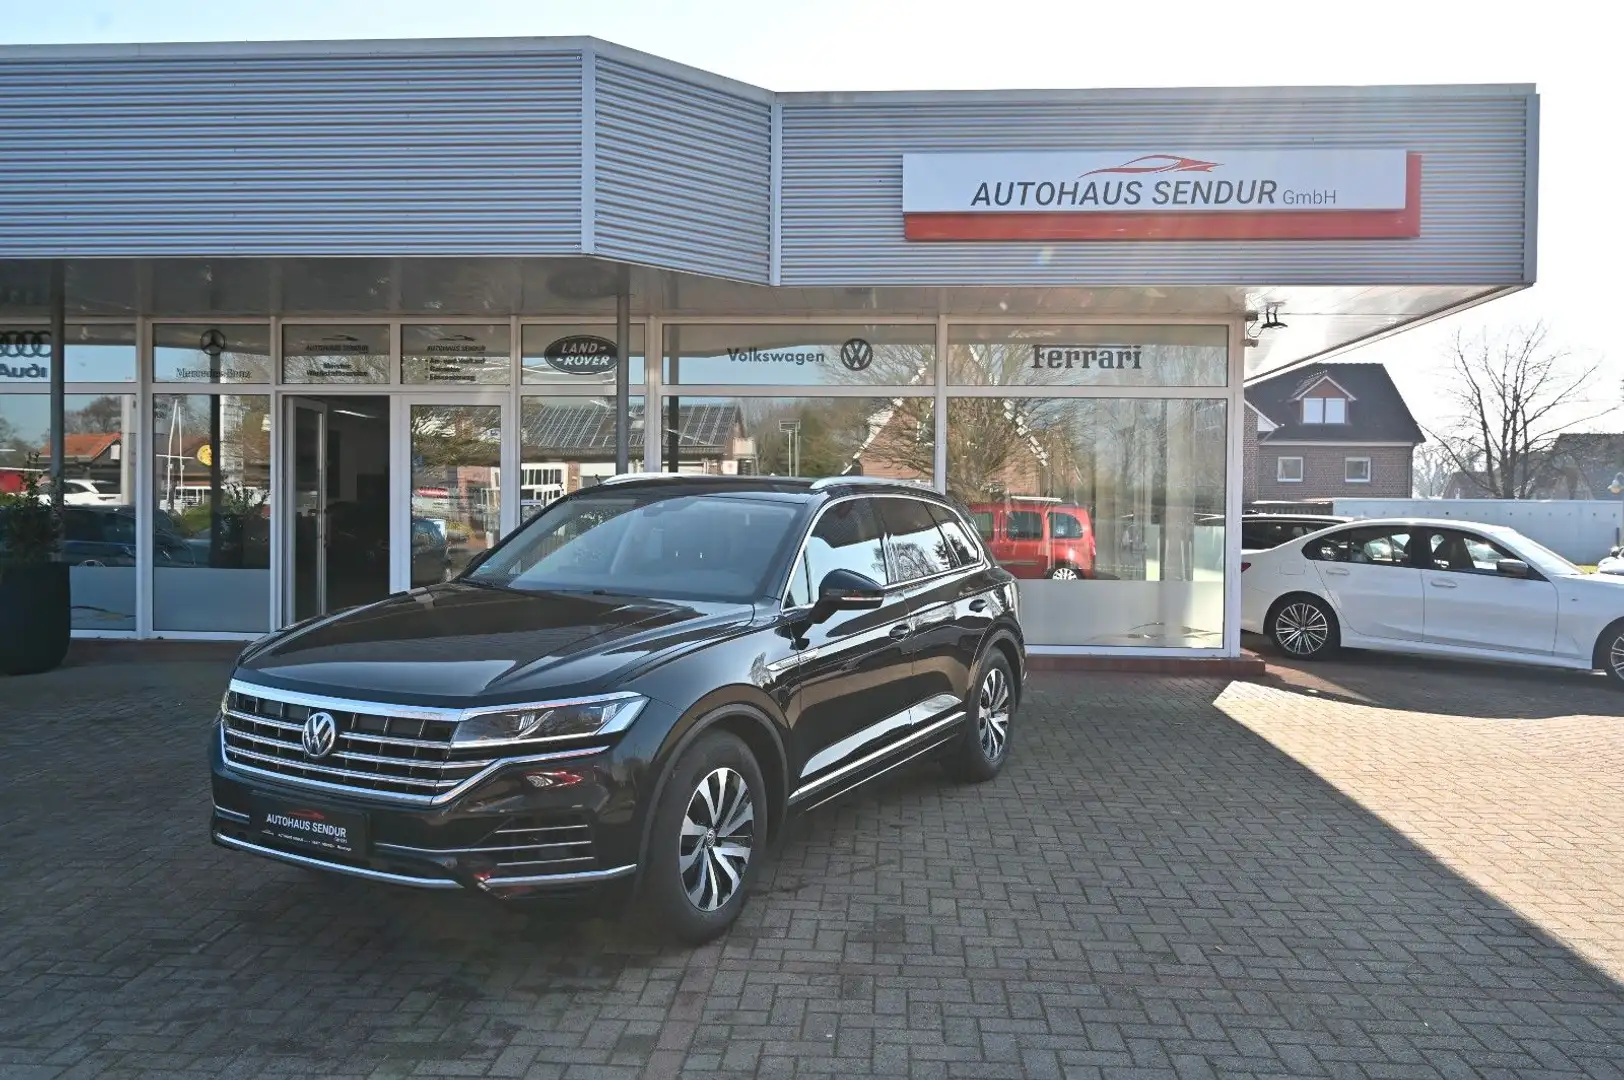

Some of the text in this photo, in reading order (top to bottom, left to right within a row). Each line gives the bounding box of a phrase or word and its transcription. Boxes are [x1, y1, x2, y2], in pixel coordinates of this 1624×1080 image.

[971, 179, 1337, 207] AUTOHAUS SENDUR GmbH
[561, 342, 599, 355] LAND
[727, 347, 825, 366] Volkswagen
[1031, 344, 1142, 370] Ferrari
[563, 355, 611, 367] ROVER
[0, 363, 48, 379] Audi
[176, 367, 252, 379] Mercedes-Benz
[265, 813, 347, 838] AUTOHAUS SENDUR
